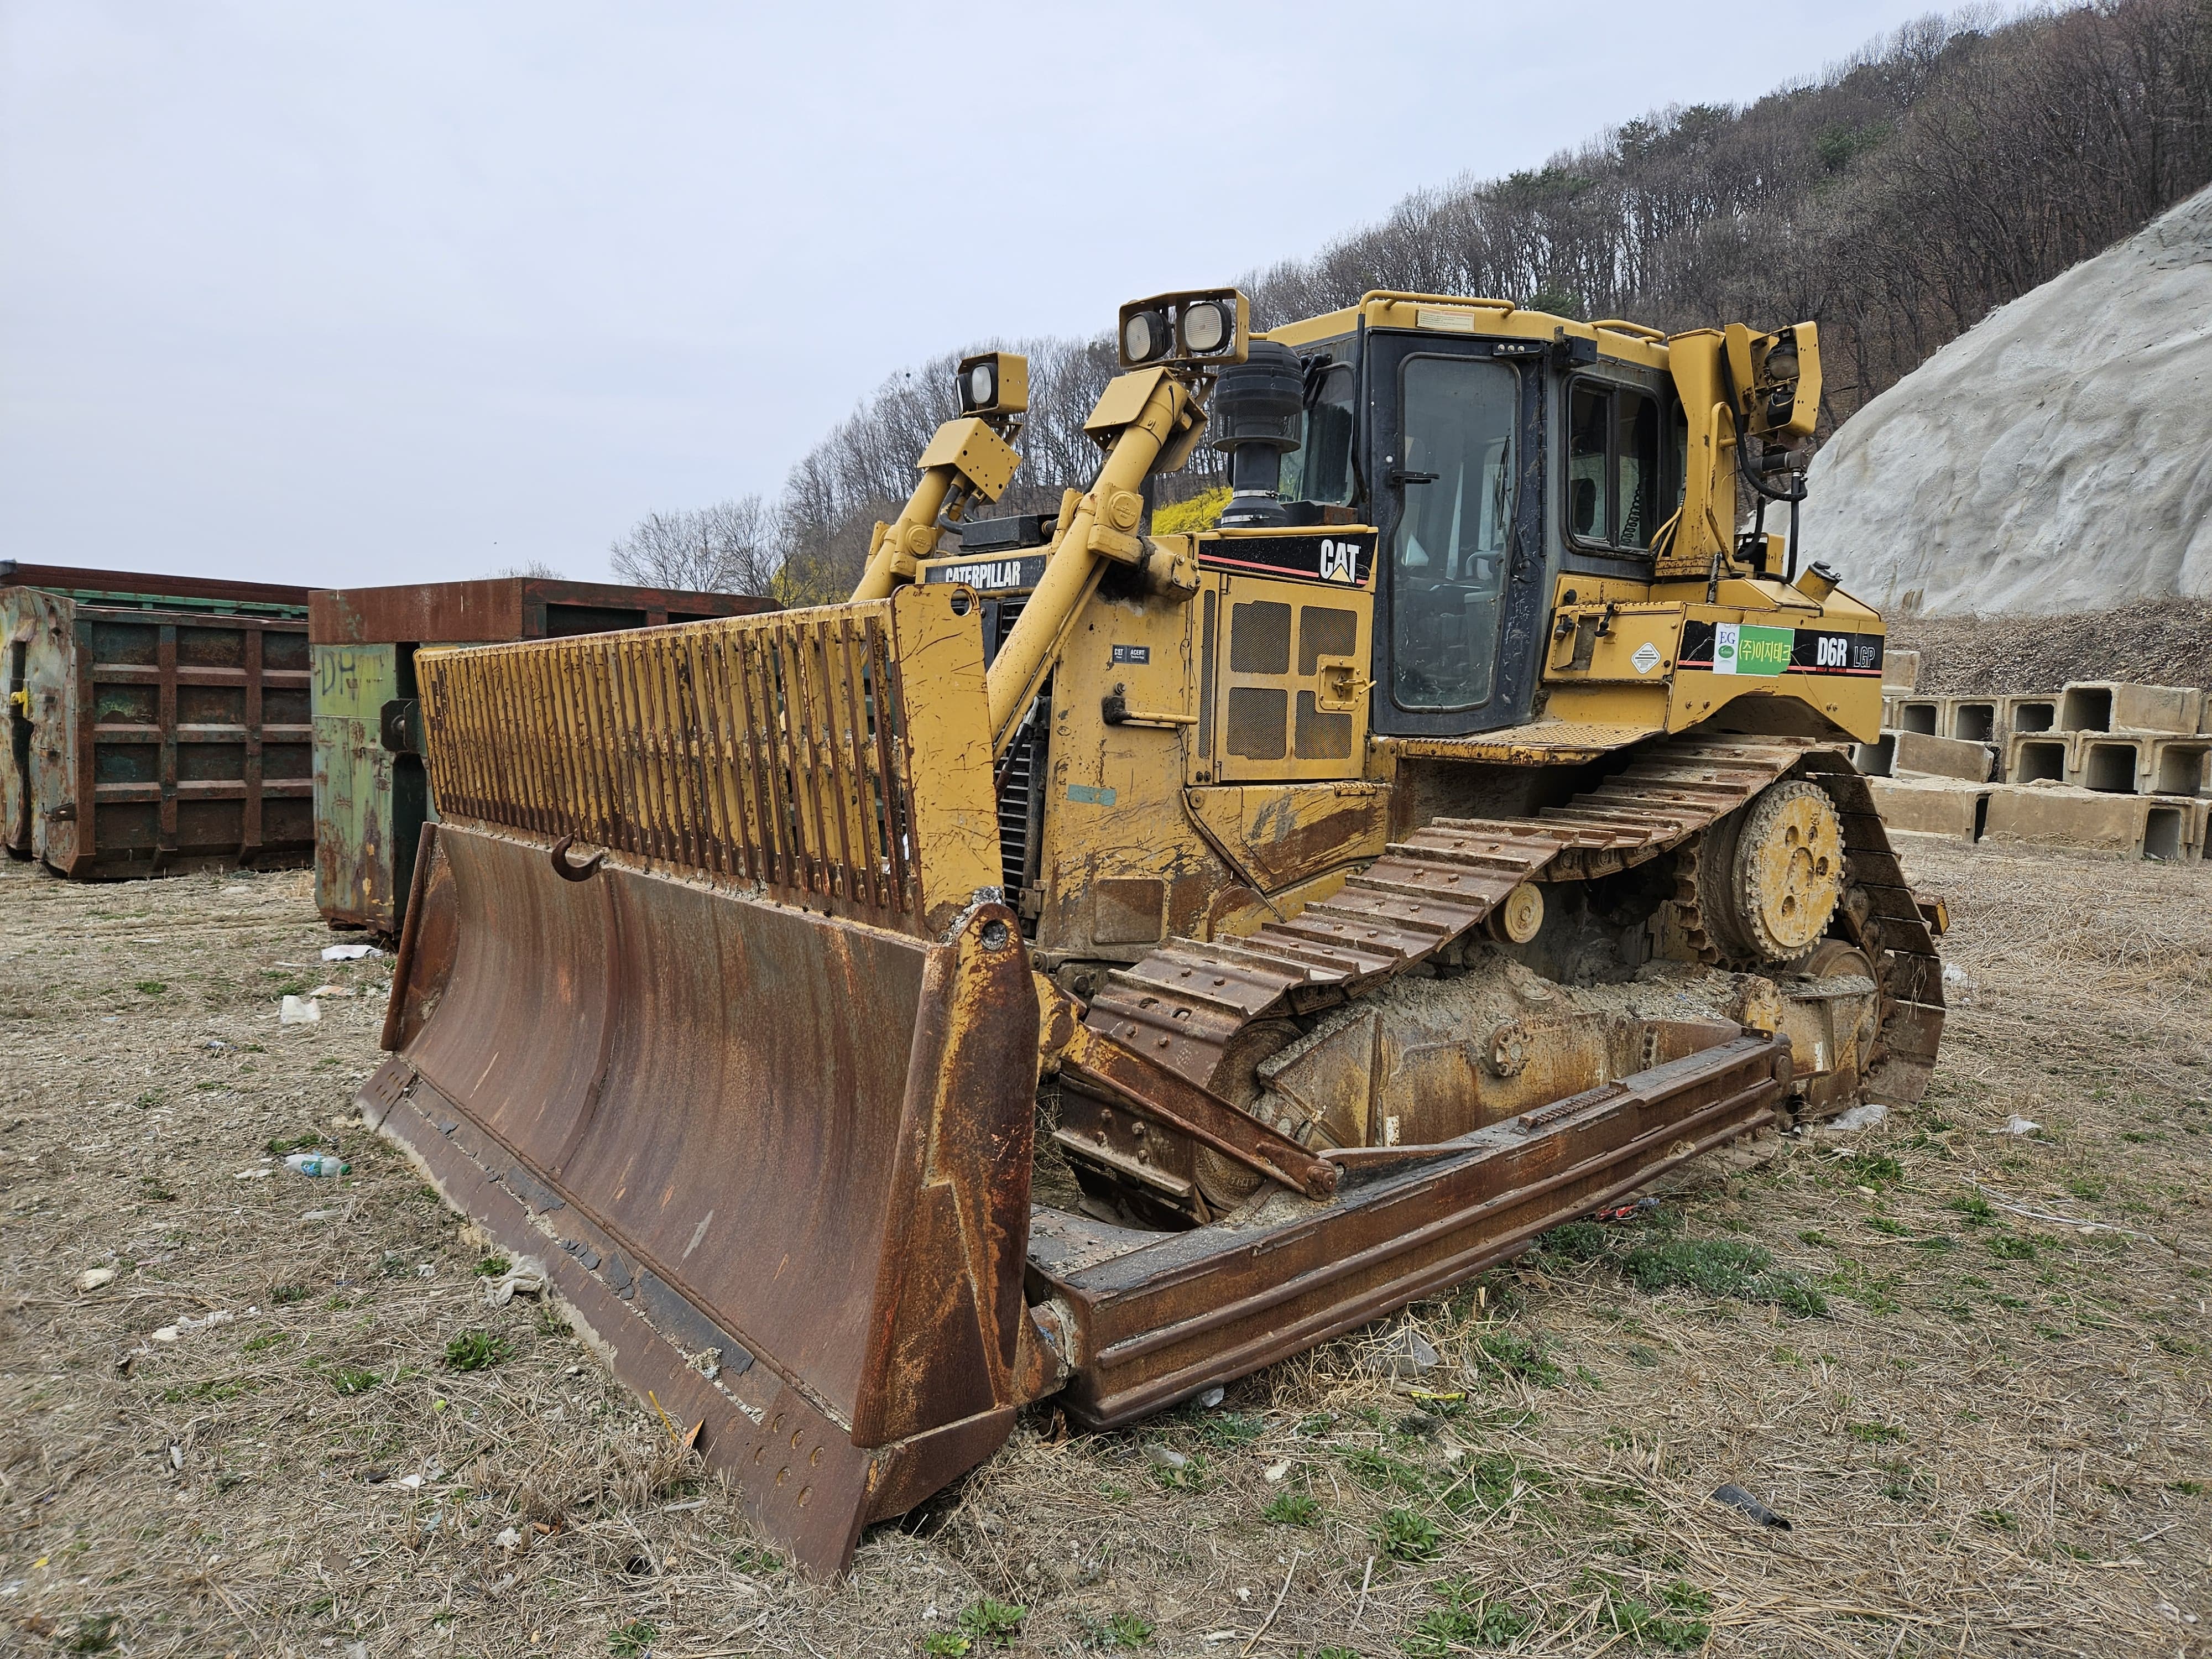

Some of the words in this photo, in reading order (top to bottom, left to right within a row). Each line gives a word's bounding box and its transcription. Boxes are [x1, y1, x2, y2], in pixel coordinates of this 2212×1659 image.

[946, 561, 1022, 589] CATERPILLAR
[1320, 539, 1360, 583] CAT
[1719, 632, 1735, 644] EG
[1739, 639, 1791, 663] (주)이지테크
[1817, 637, 1847, 666] D6R
[1853, 646, 1875, 667] LGP
